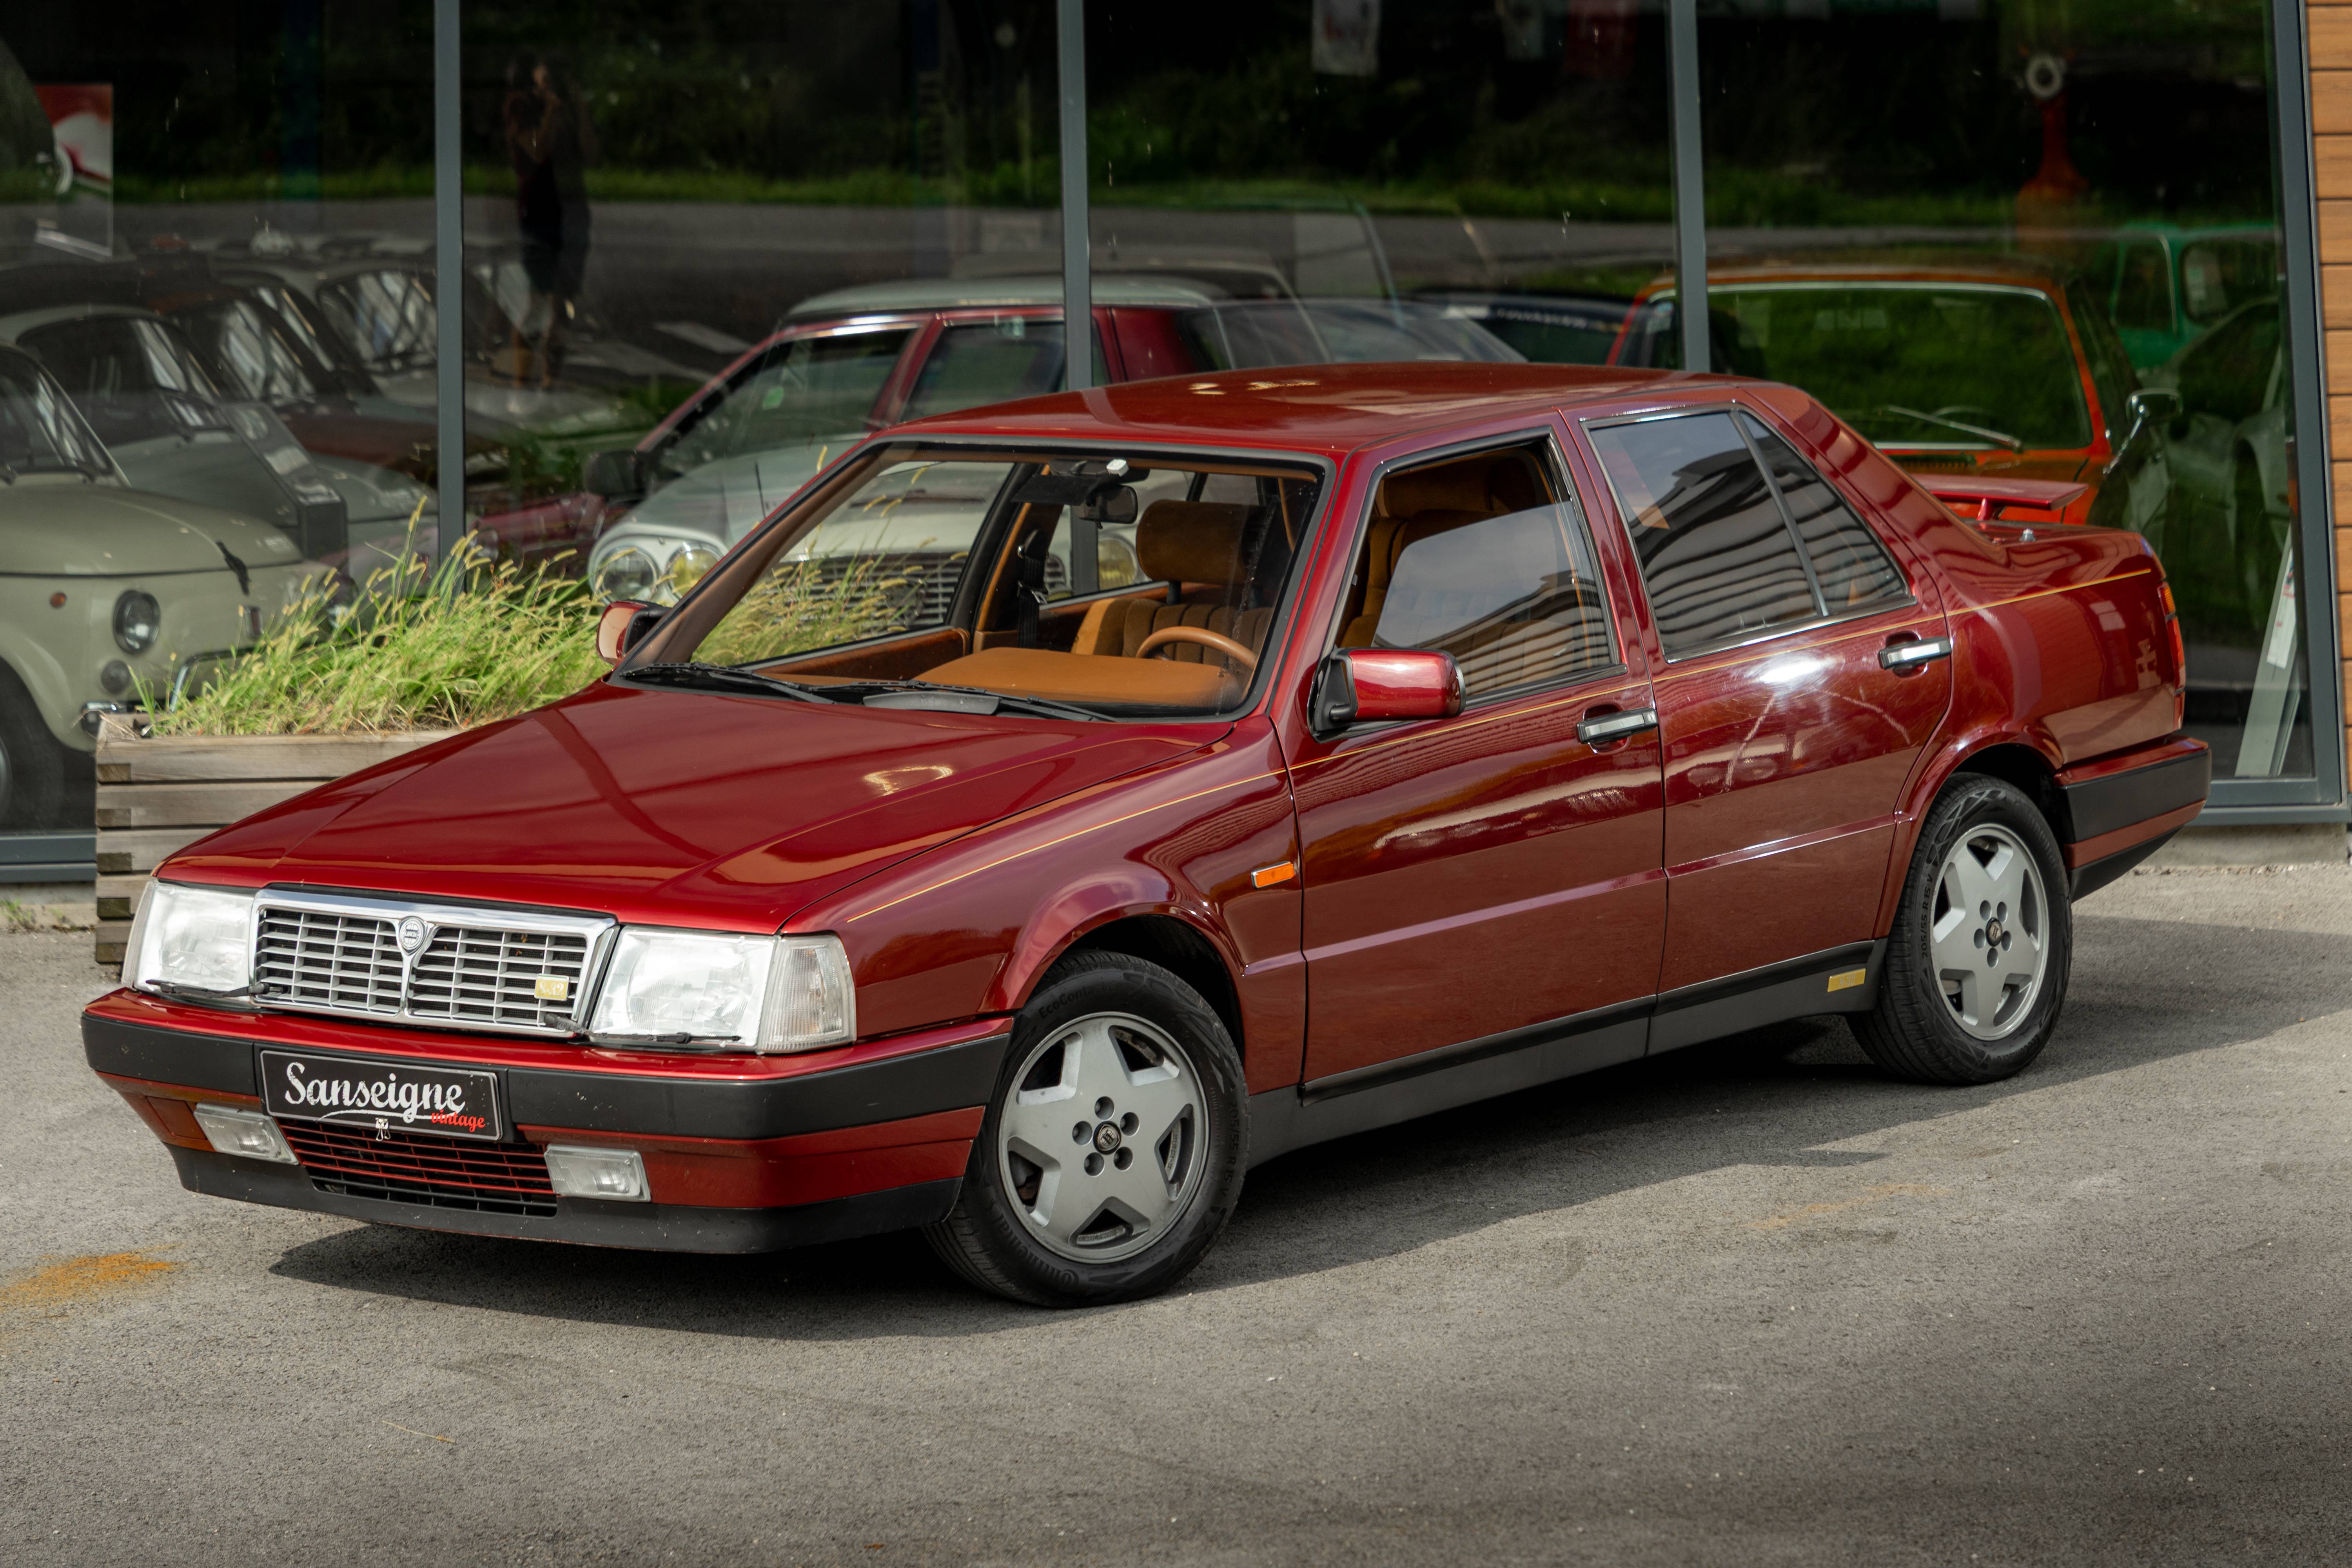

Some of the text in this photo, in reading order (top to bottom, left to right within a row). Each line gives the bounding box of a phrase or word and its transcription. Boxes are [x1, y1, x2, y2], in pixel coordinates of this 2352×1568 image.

[1926, 873, 1933, 883] V
[1924, 887, 1931, 900] 15
[1922, 901, 1929, 910] R
[1038, 984, 1106, 1019] EcoContact
[285, 1062, 466, 1123] Sanseigne
[432, 1110, 486, 1132] vintage
[1229, 1100, 1240, 1151] 205/55
[1227, 1156, 1237, 1165] R
